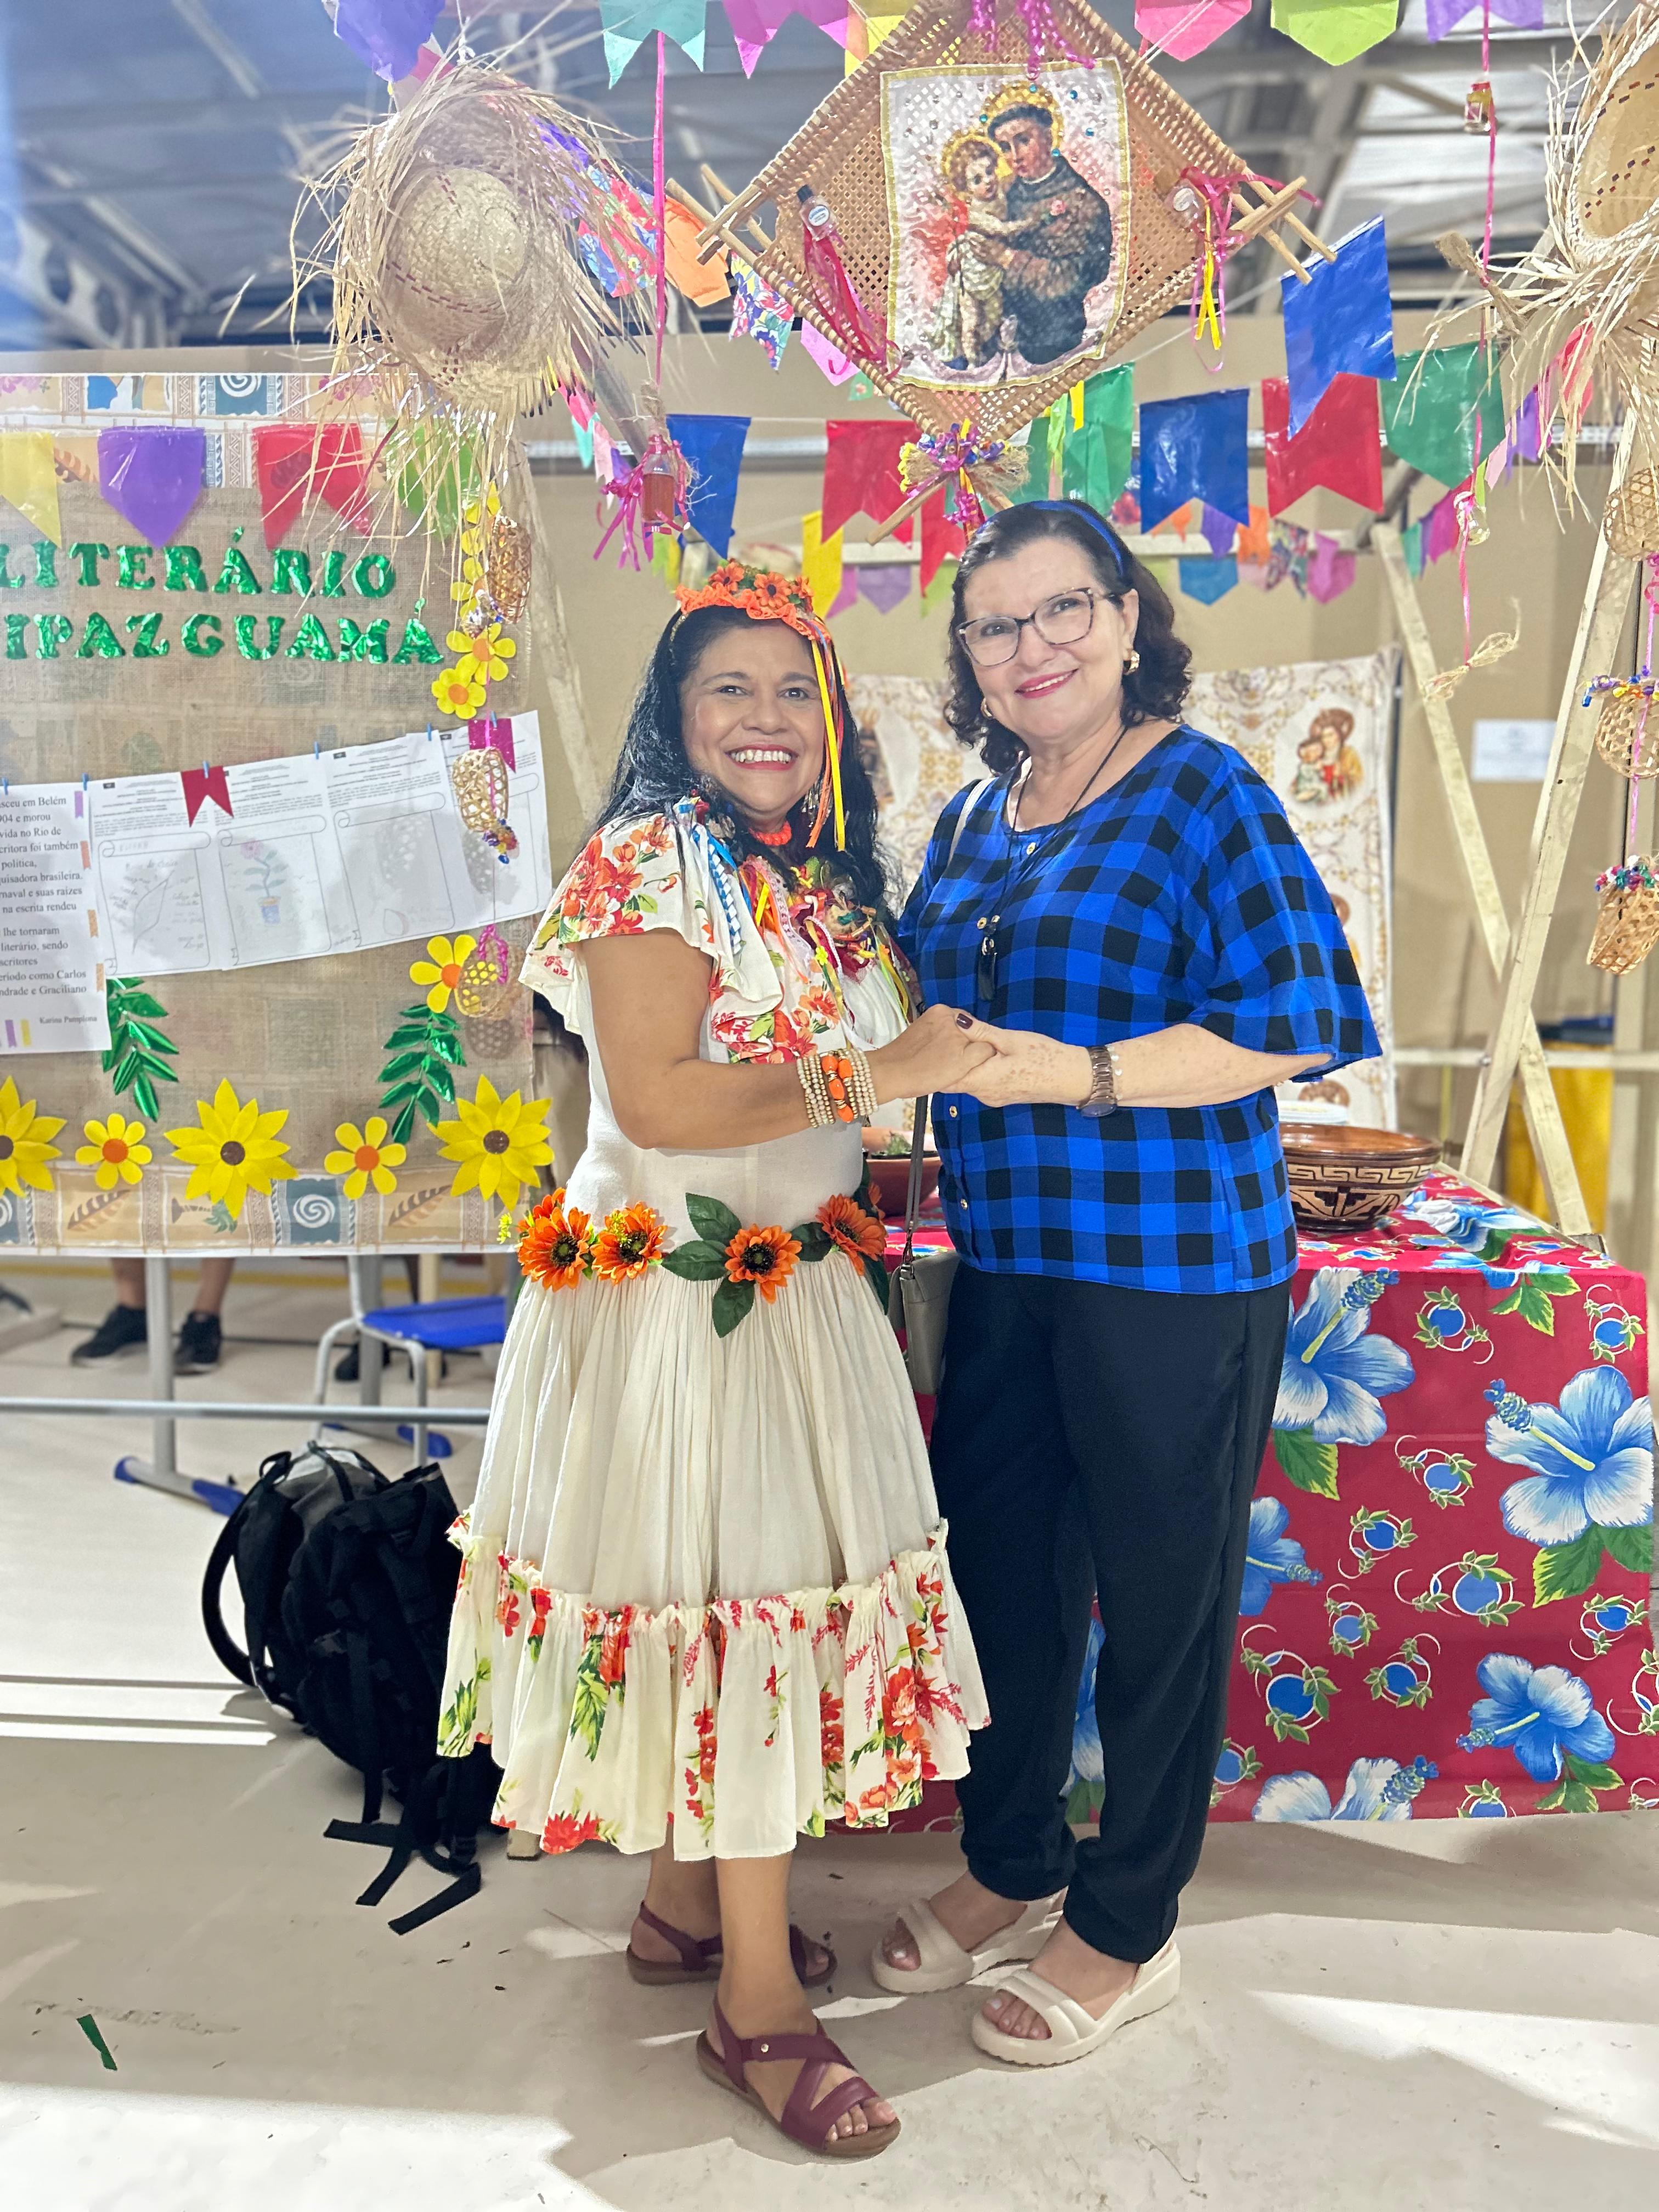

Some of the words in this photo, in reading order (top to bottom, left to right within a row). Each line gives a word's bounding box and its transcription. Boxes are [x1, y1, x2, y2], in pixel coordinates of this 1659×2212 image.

[0, 526, 396, 599] LITERÁRIO
[38, 796, 66, 806] Belém
[23, 814, 51, 822] morou
[0, 828, 18, 838] vida
[34, 826, 49, 837] Rio
[51, 827, 61, 836] de
[30, 842, 41, 852] foi
[44, 841, 78, 851] também
[15, 903, 44, 913] escrita
[47, 901, 77, 911] rendeu
[3, 927, 17, 936] lhe
[20, 927, 60, 936] tornaram
[42, 940, 69, 950] sendo
[57, 969, 87, 980] Carlos
[39, 984, 87, 995] Graciliano
